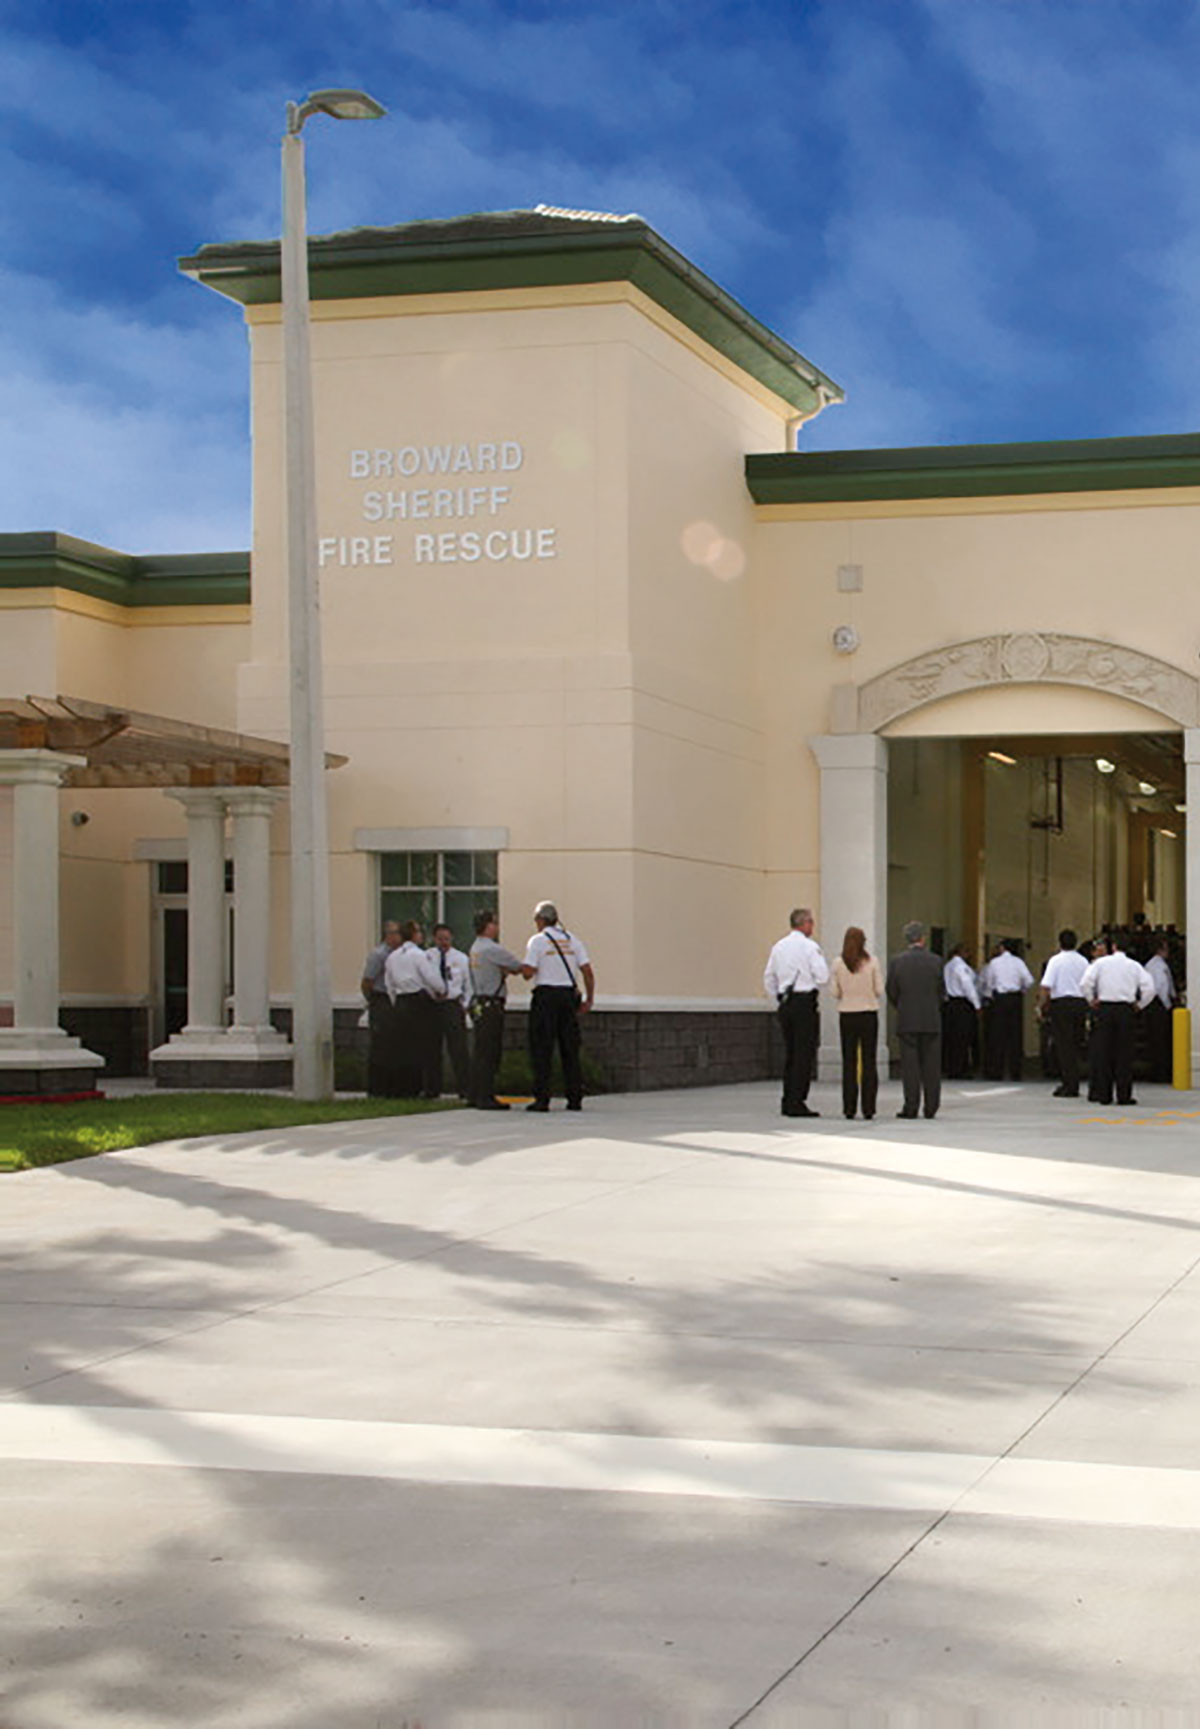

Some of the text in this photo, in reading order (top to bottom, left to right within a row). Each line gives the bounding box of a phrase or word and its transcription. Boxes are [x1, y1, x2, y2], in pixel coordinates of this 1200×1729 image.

[350, 441, 523, 478] BROWARD
[363, 486, 510, 521] SHERIFF
[318, 528, 556, 567] FIRE RESCUE
